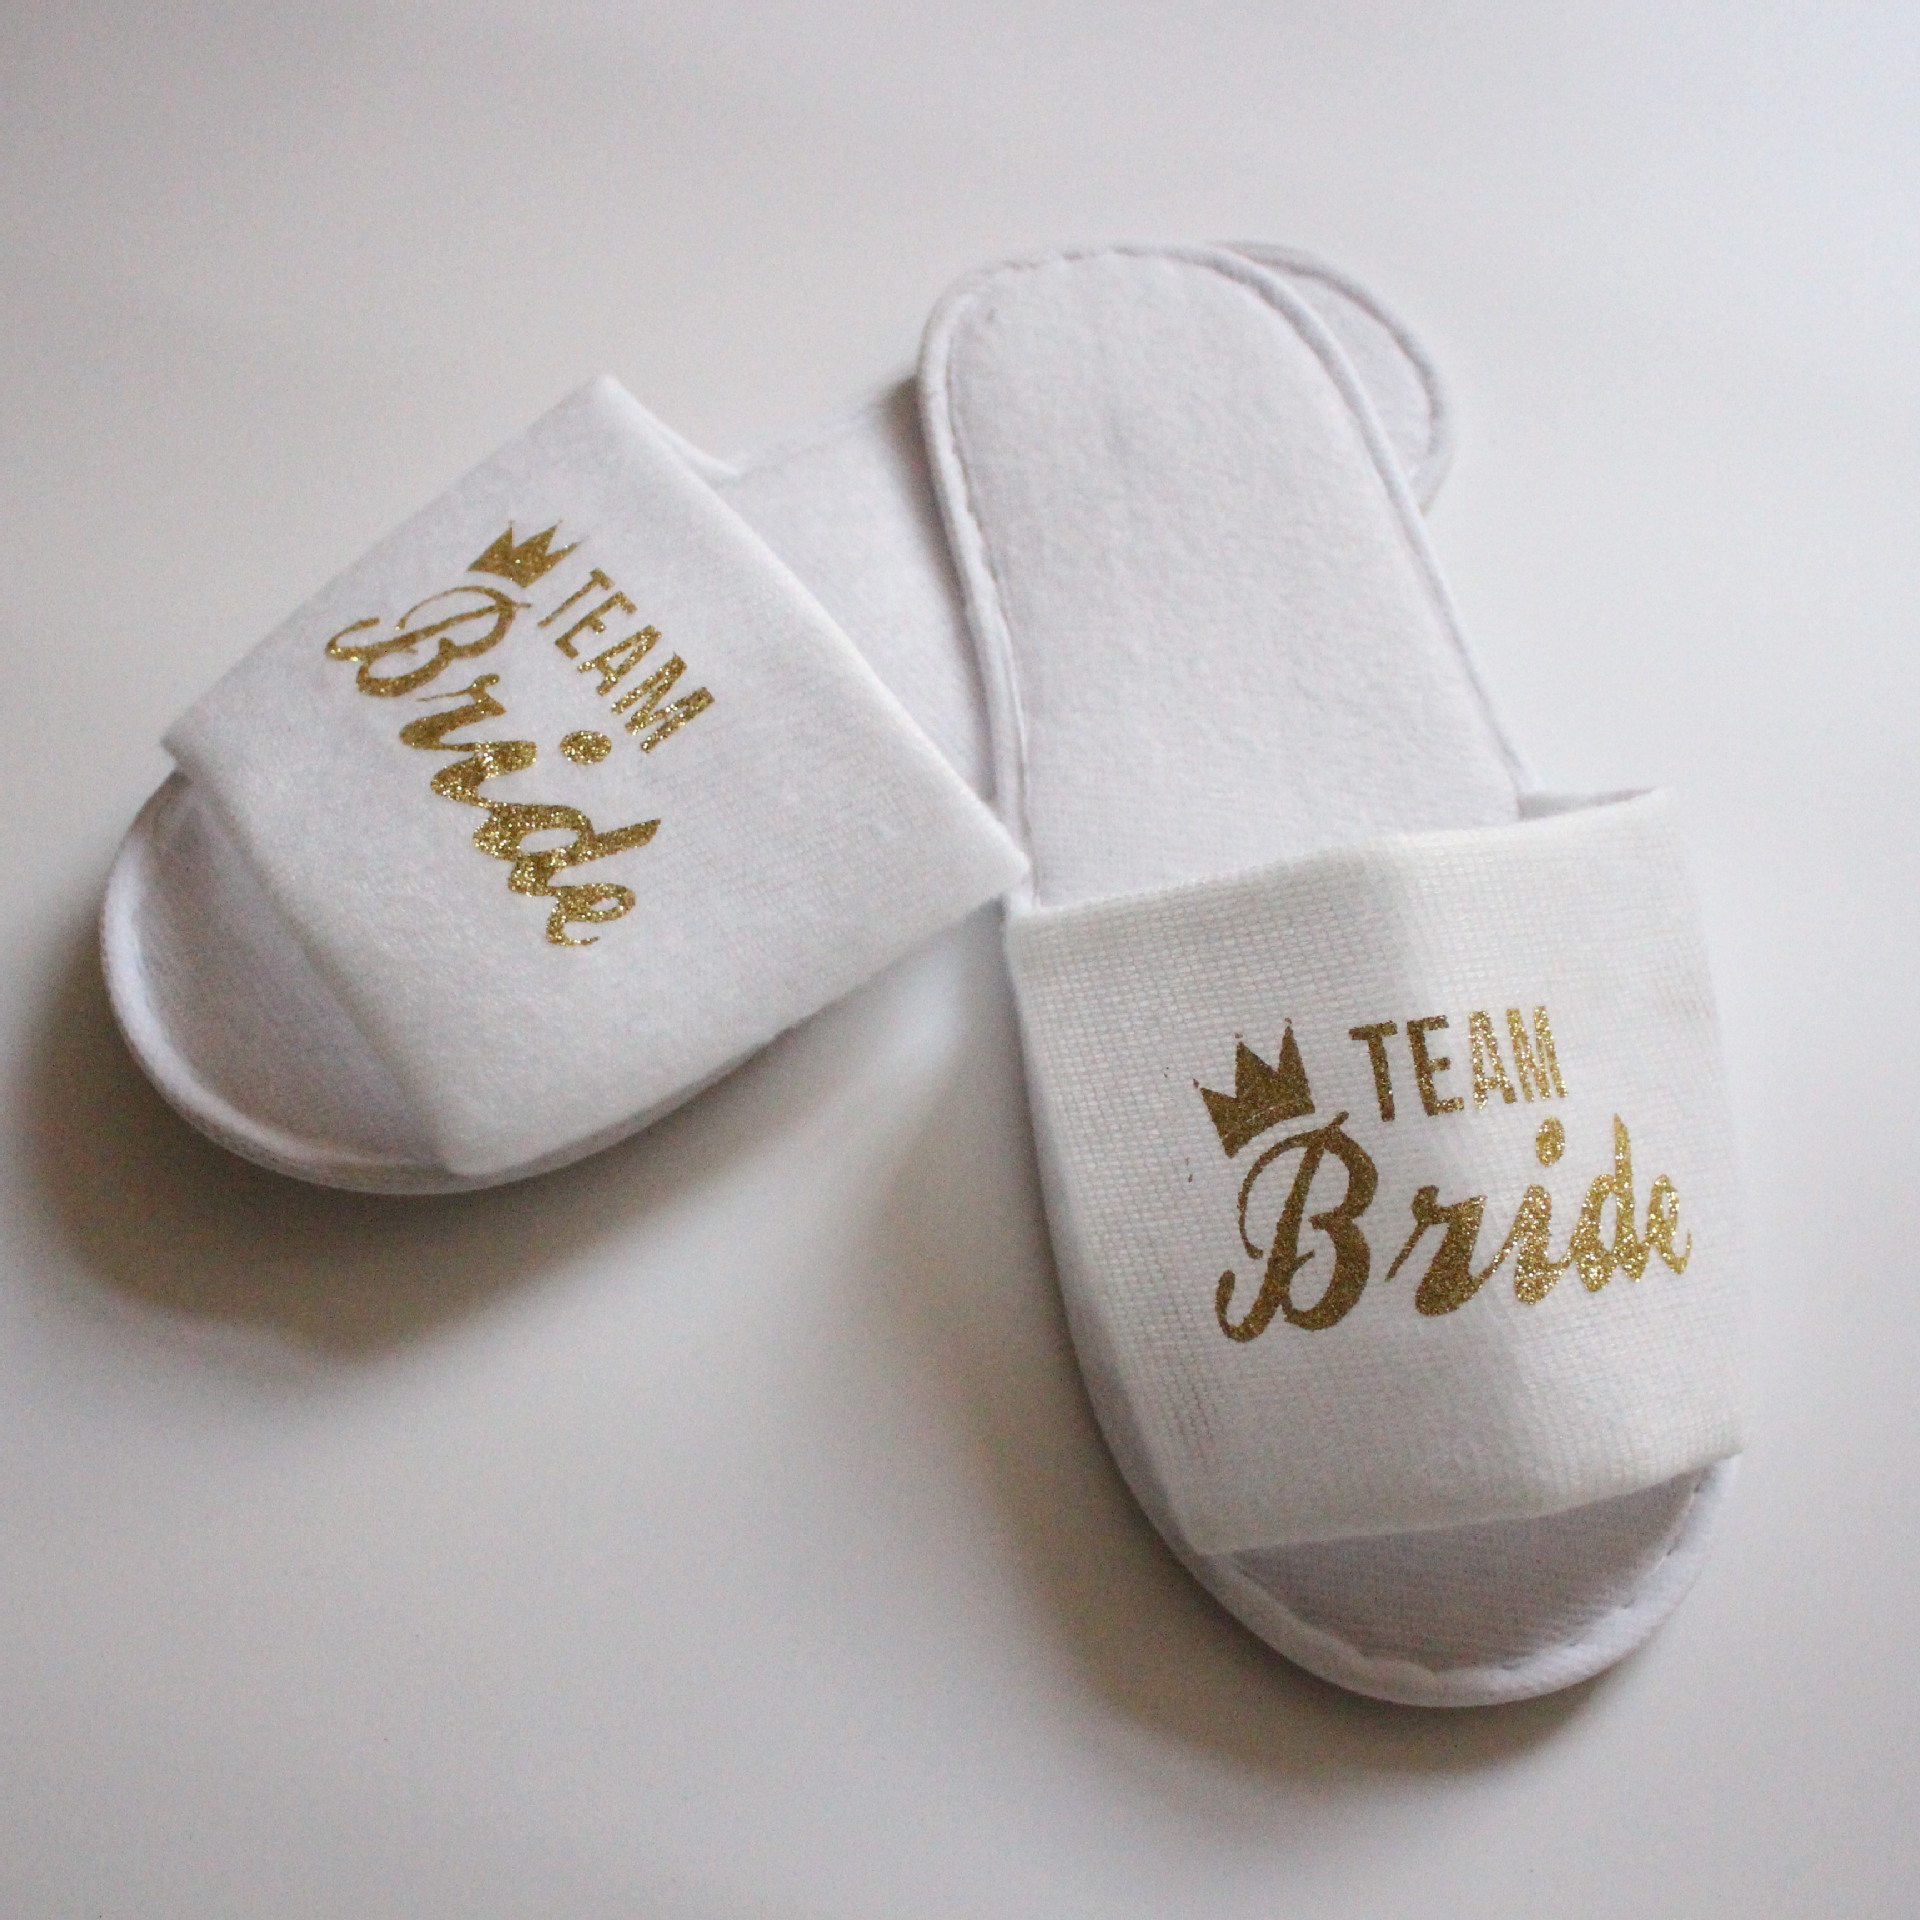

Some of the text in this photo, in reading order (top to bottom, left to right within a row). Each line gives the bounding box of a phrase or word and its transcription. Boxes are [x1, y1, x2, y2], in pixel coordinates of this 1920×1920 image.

[537, 567, 715, 754] TEAM
[325, 585, 661, 947] Bride
[1348, 1005, 1567, 1122] TEAM
[1215, 1111, 1692, 1343] Bride
